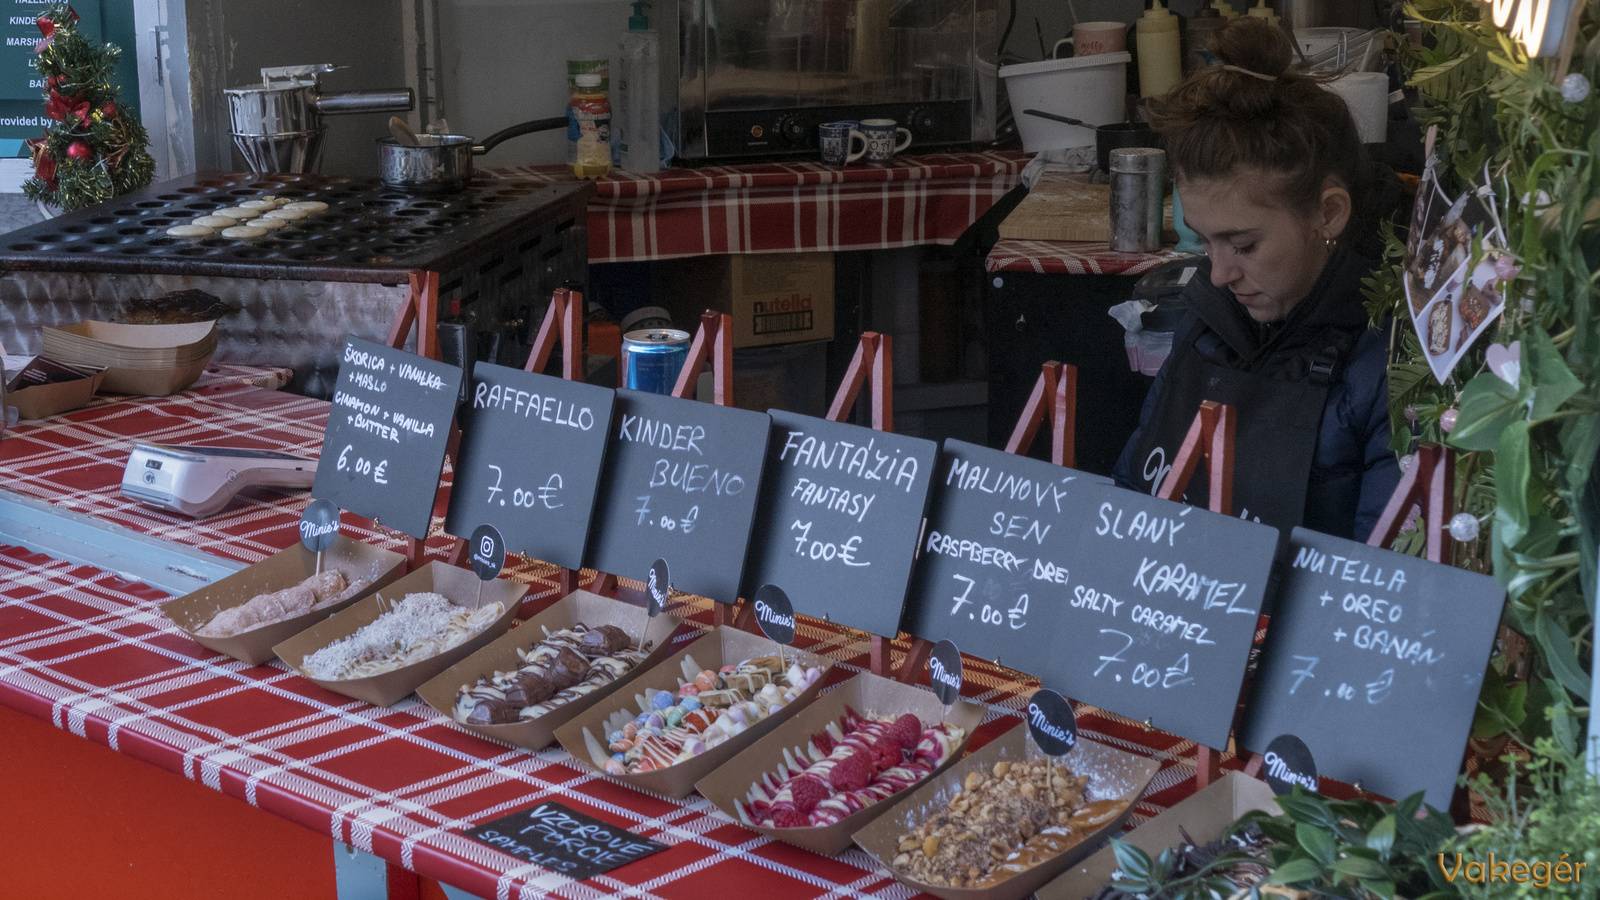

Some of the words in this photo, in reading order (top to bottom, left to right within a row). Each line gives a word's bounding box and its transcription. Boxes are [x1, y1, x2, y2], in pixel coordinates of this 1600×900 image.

[9, 16, 37, 25] KINDE
[40, 116, 53, 128] by
[753, 293, 813, 313] nutella
[344, 343, 385, 370] ŠKORICA
[334, 390, 380, 416] CINAMON
[393, 412, 435, 437] VANILLA
[473, 381, 594, 431] RAFFAELLO
[619, 413, 706, 456] KINDER
[649, 458, 745, 496] BUENO
[946, 457, 1077, 513] MALINOVÝ
[791, 478, 876, 523] FANTASY
[300, 520, 340, 539] Minie's
[989, 511, 1051, 545] SEN
[1095, 501, 1192, 547] SLANÝ
[926, 531, 1029, 572] RASPBERRY
[1292, 546, 1407, 592] NUTELLA
[1133, 556, 1256, 615] KARAMEL
[755, 600, 796, 630] Minie's
[1070, 585, 1125, 617] SALTY
[1131, 604, 1217, 645] CARAMEL
[1342, 592, 1403, 624] OREO
[1353, 625, 1446, 665] BANÁN
[930, 656, 961, 690] Minie's
[1028, 702, 1075, 746] Minie's
[1264, 751, 1318, 792] Minie's
